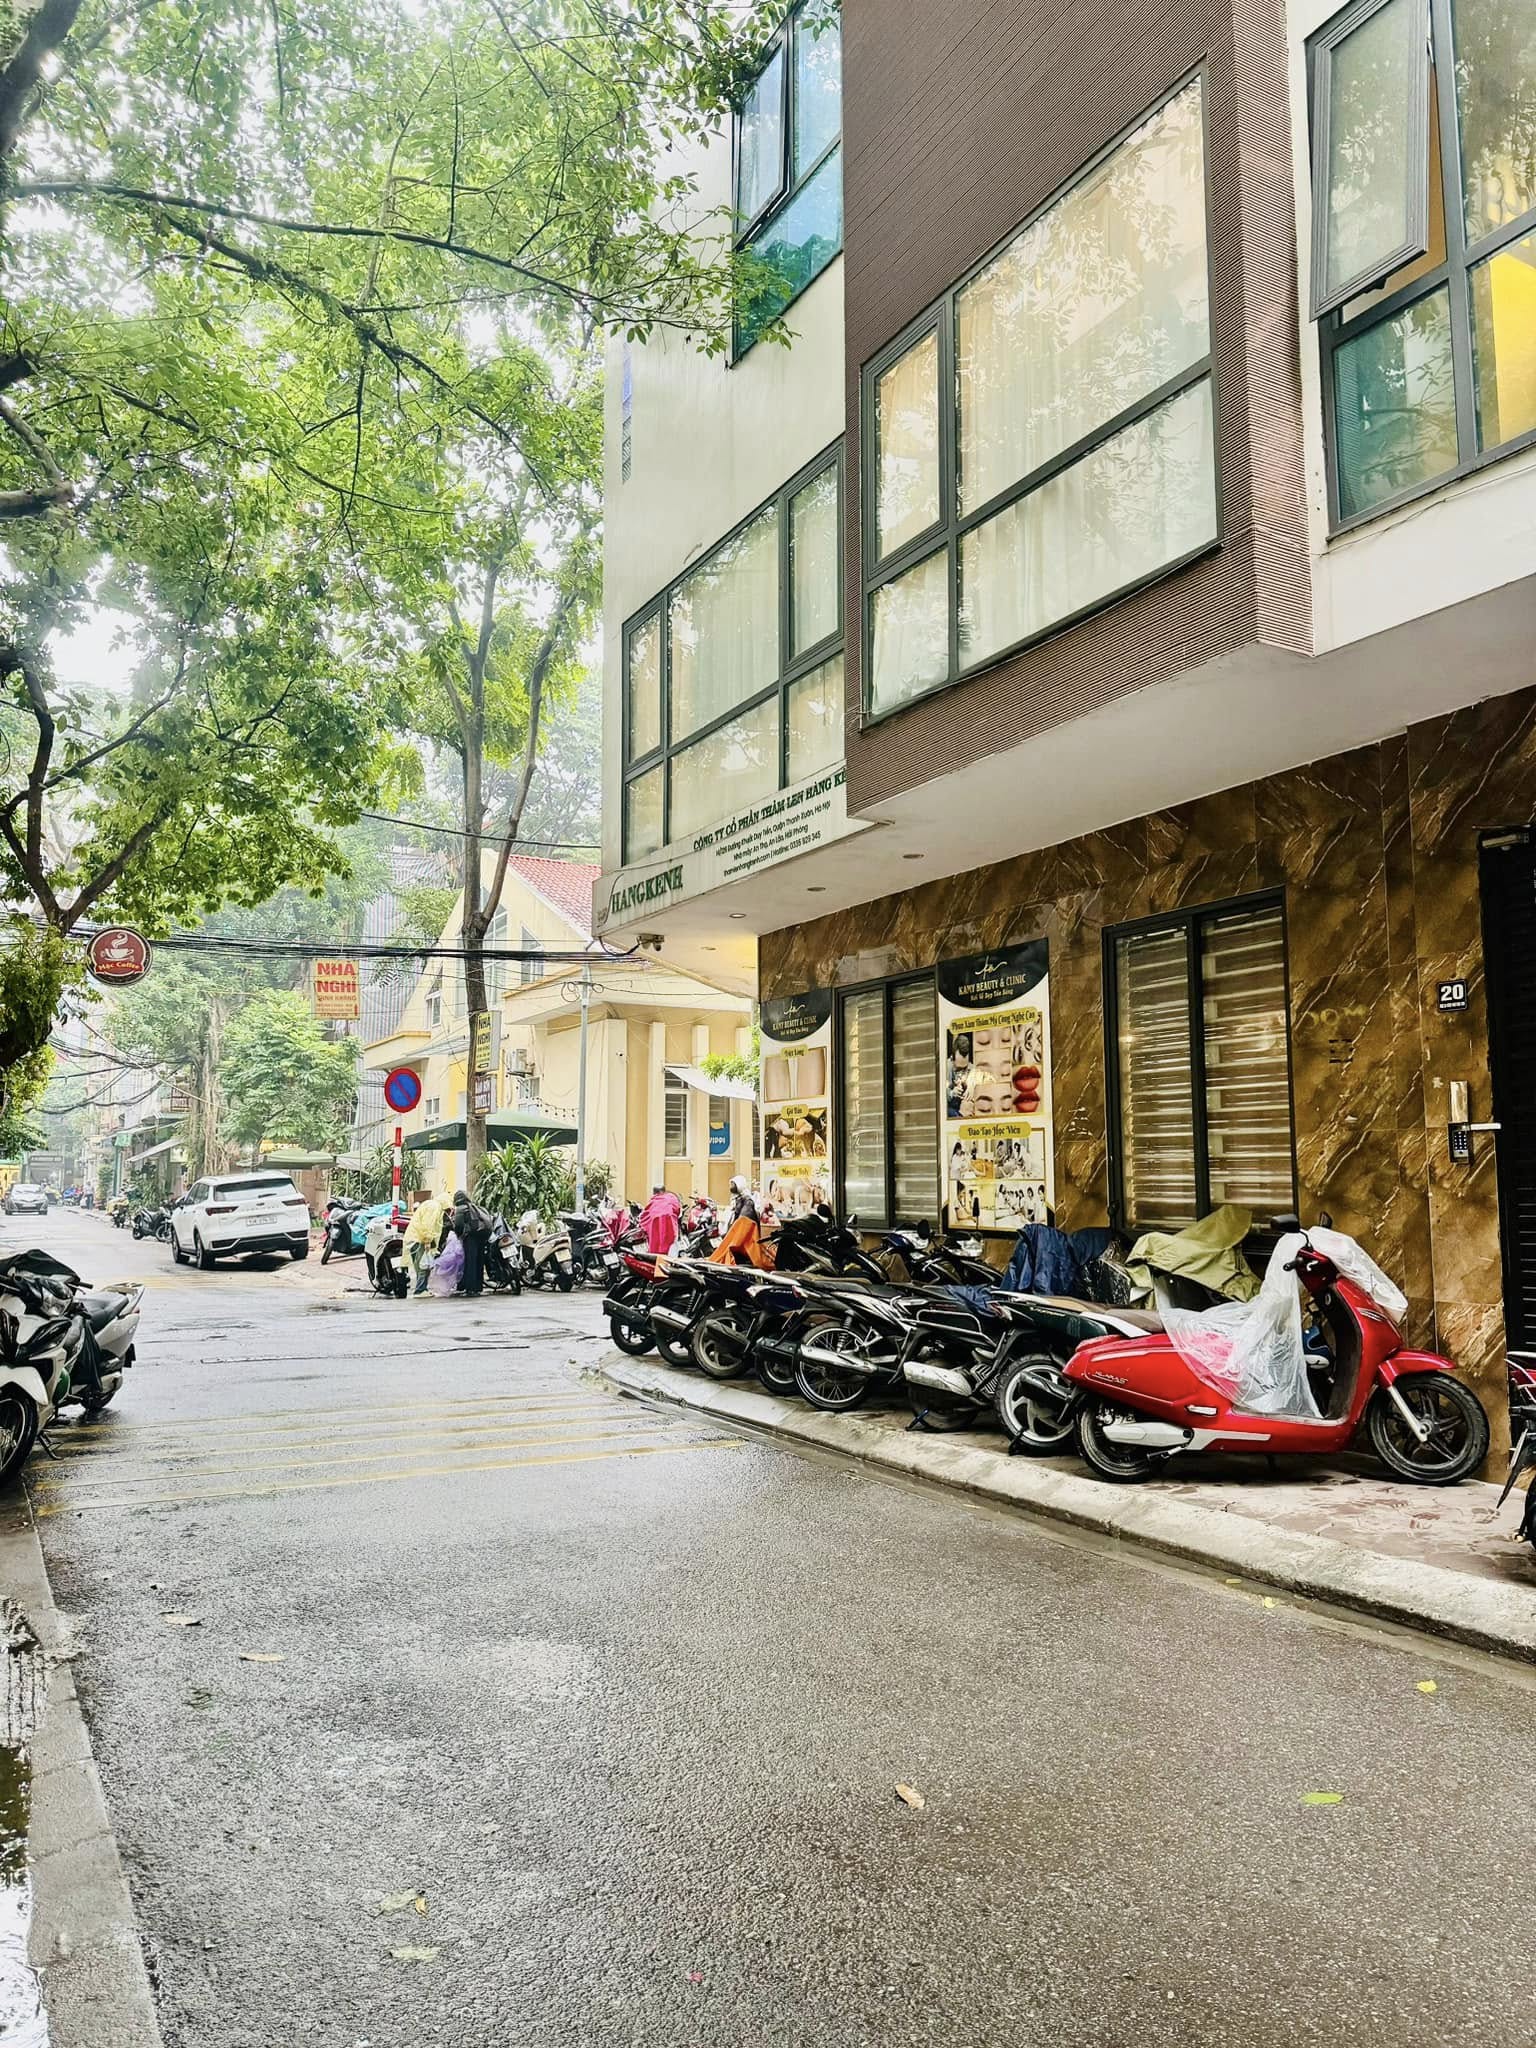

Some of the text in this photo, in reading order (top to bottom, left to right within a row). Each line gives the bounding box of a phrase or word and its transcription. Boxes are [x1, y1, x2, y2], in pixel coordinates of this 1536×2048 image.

[693, 833, 713, 850] CÔNG
[715, 827, 724, 841] TY
[787, 790, 804, 809] LEN
[805, 777, 832, 800] HÀNG
[611, 864, 683, 914] HANGKENH
[317, 960, 355, 976] NHÀ
[316, 976, 357, 993] NGHỈ
[976, 979, 999, 992] BEAUTY
[1006, 973, 1026, 986] CLINIC
[1440, 983, 1464, 1001] 20
